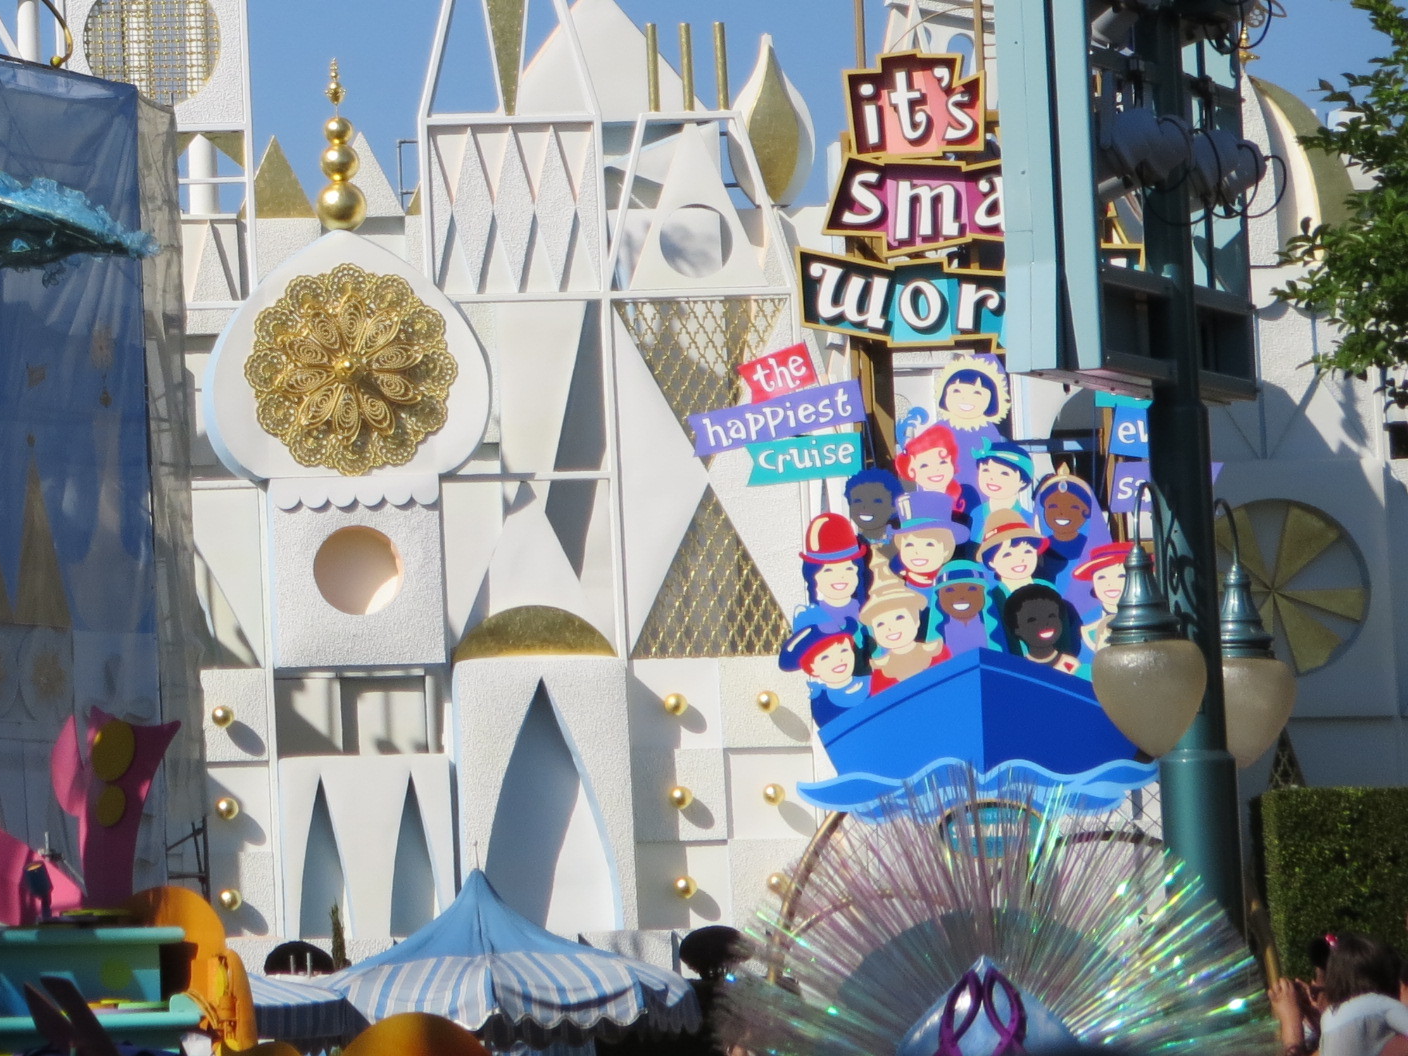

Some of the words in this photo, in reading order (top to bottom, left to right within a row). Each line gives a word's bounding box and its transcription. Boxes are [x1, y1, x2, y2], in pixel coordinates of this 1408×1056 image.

[859, 65, 975, 145] it's
[841, 171, 1005, 241] sma
[809, 261, 1001, 331] wor
[752, 354, 808, 393] the
[701, 387, 853, 448] happiest
[757, 439, 856, 475] cruise
